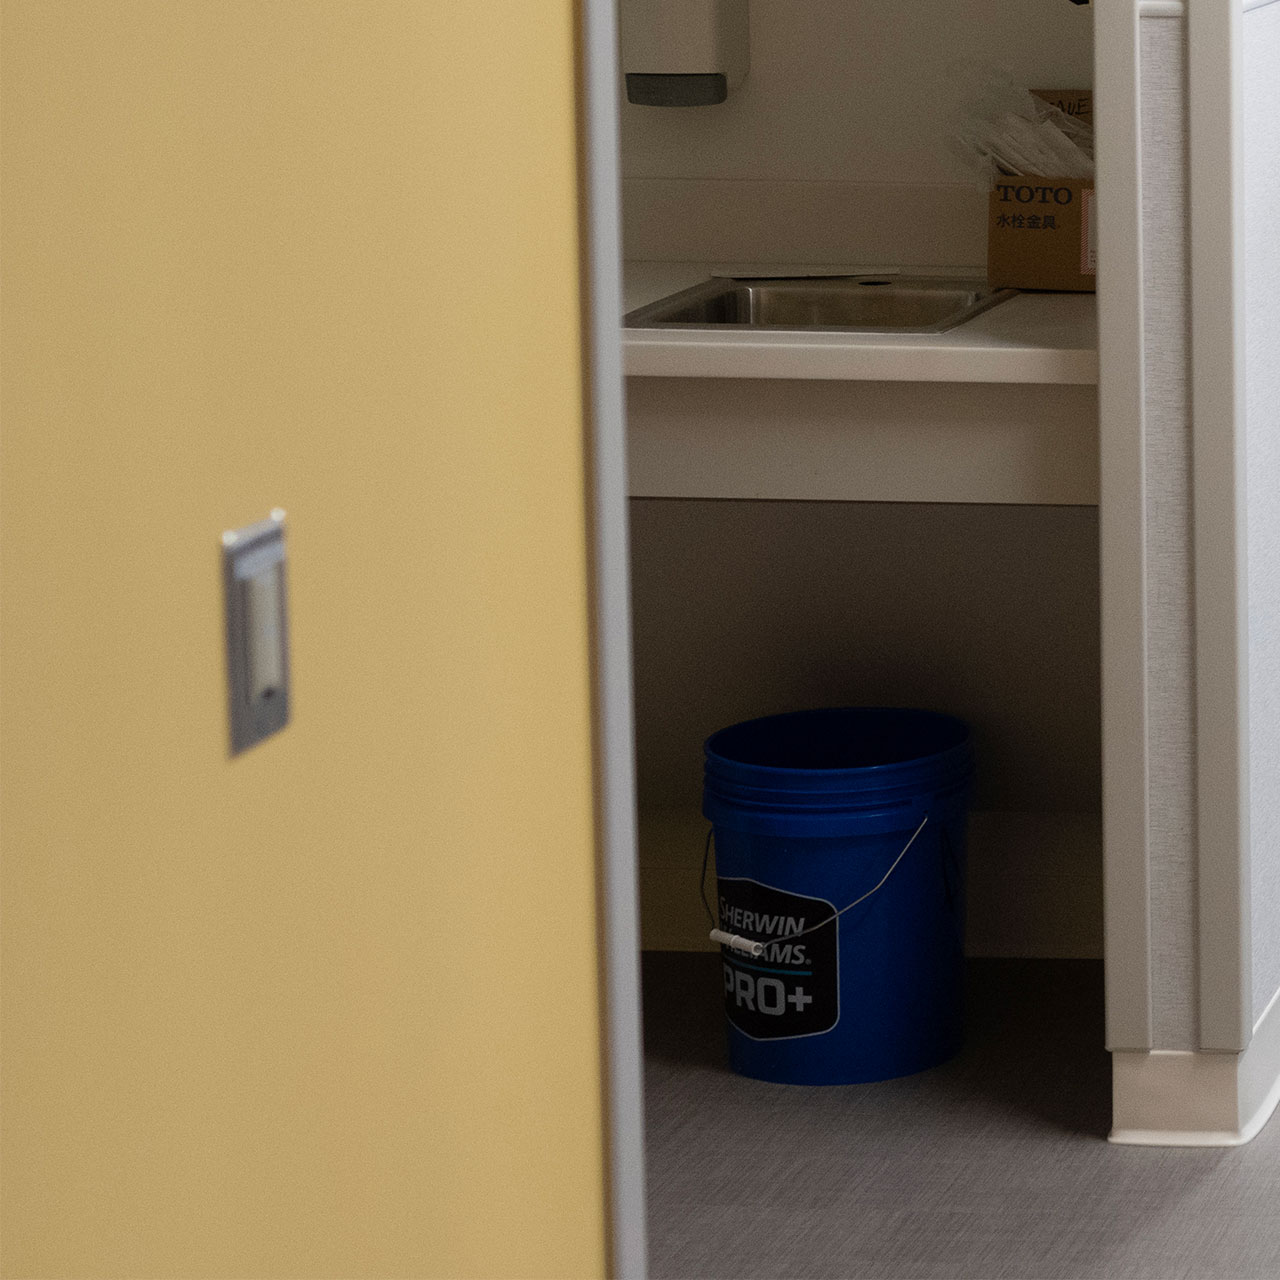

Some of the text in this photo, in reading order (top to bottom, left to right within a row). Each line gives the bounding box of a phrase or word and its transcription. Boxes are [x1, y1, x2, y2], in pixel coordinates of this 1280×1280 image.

[996, 184, 1073, 205] TOTO
[719, 896, 805, 936] SHERWIN
[723, 961, 813, 1016] PRO+
